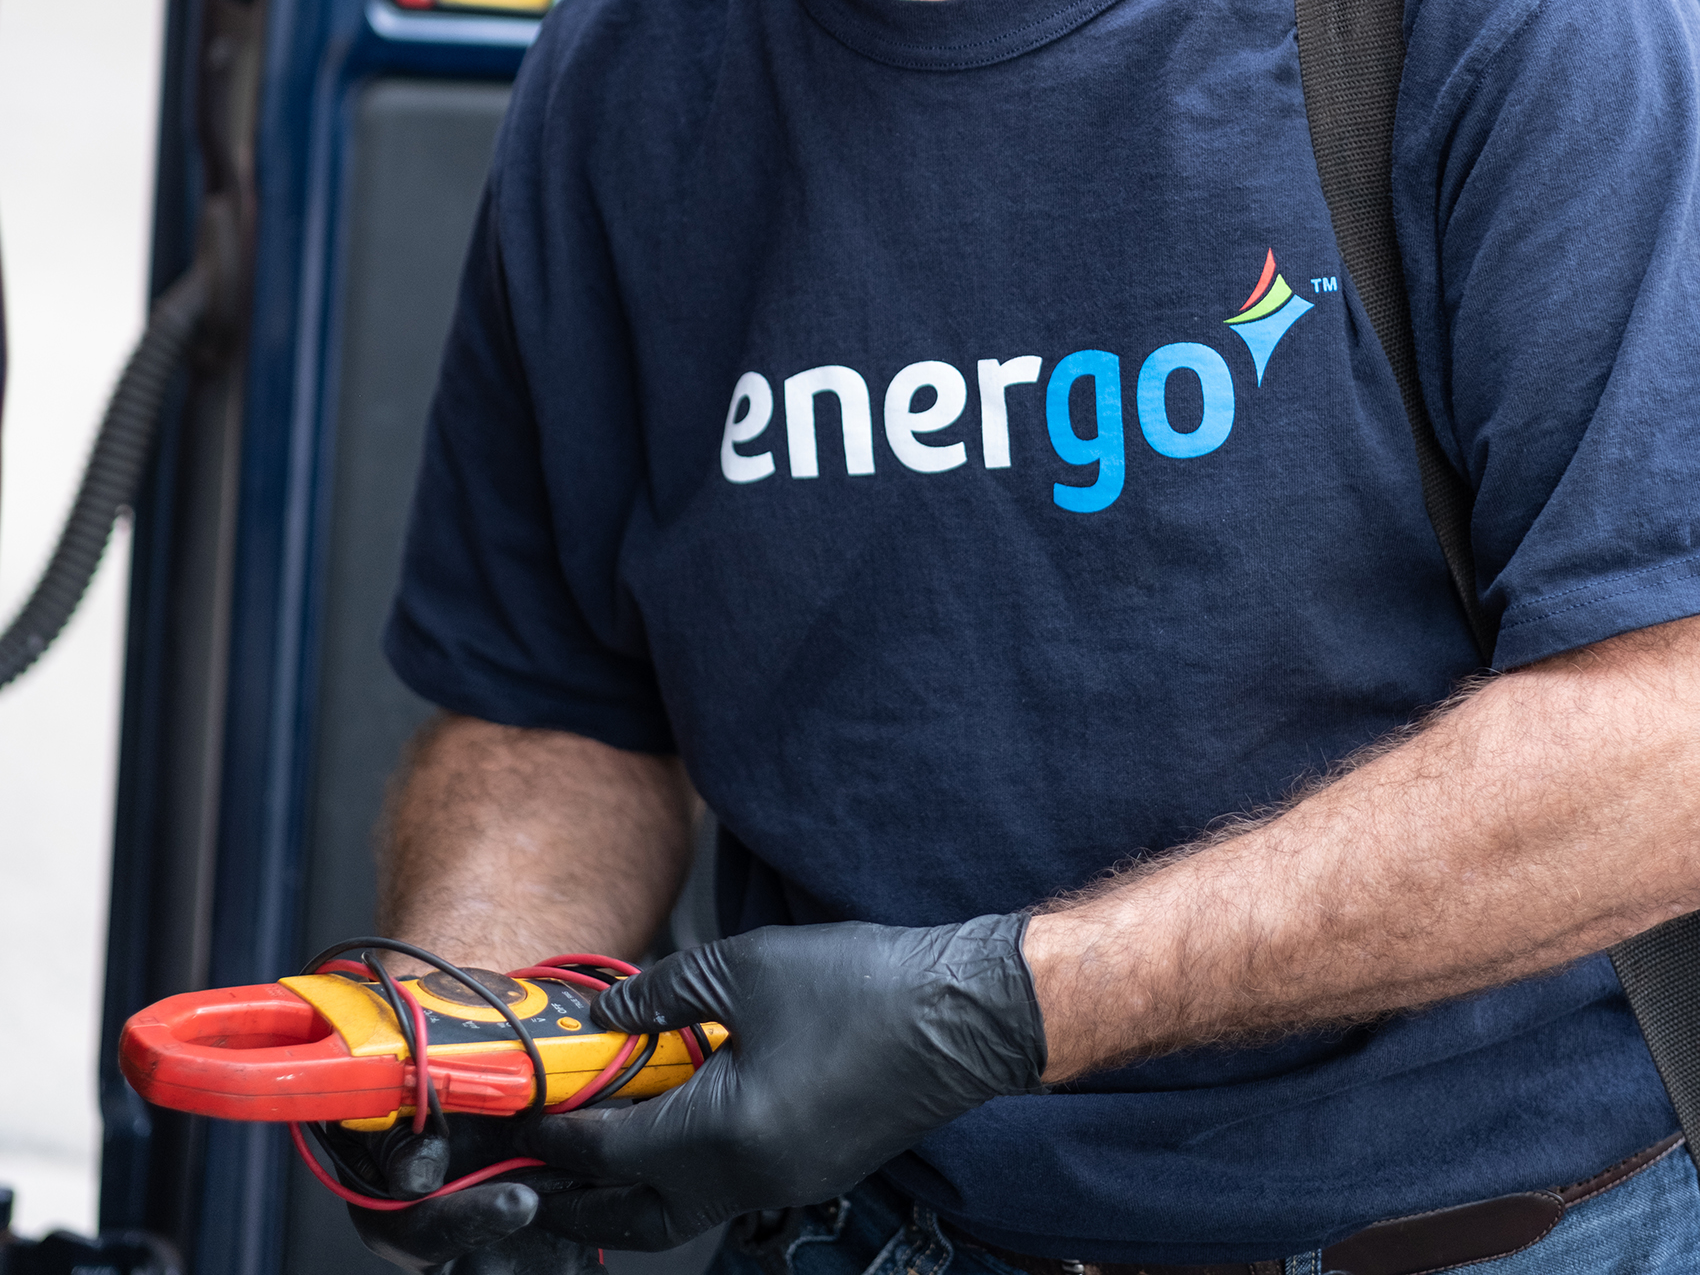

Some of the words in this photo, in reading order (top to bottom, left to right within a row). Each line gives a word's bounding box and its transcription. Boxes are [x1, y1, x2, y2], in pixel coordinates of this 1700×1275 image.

[720, 342, 1235, 513] energo
[1310, 276, 1338, 293] TM
[551, 1003, 567, 1013] OFF
